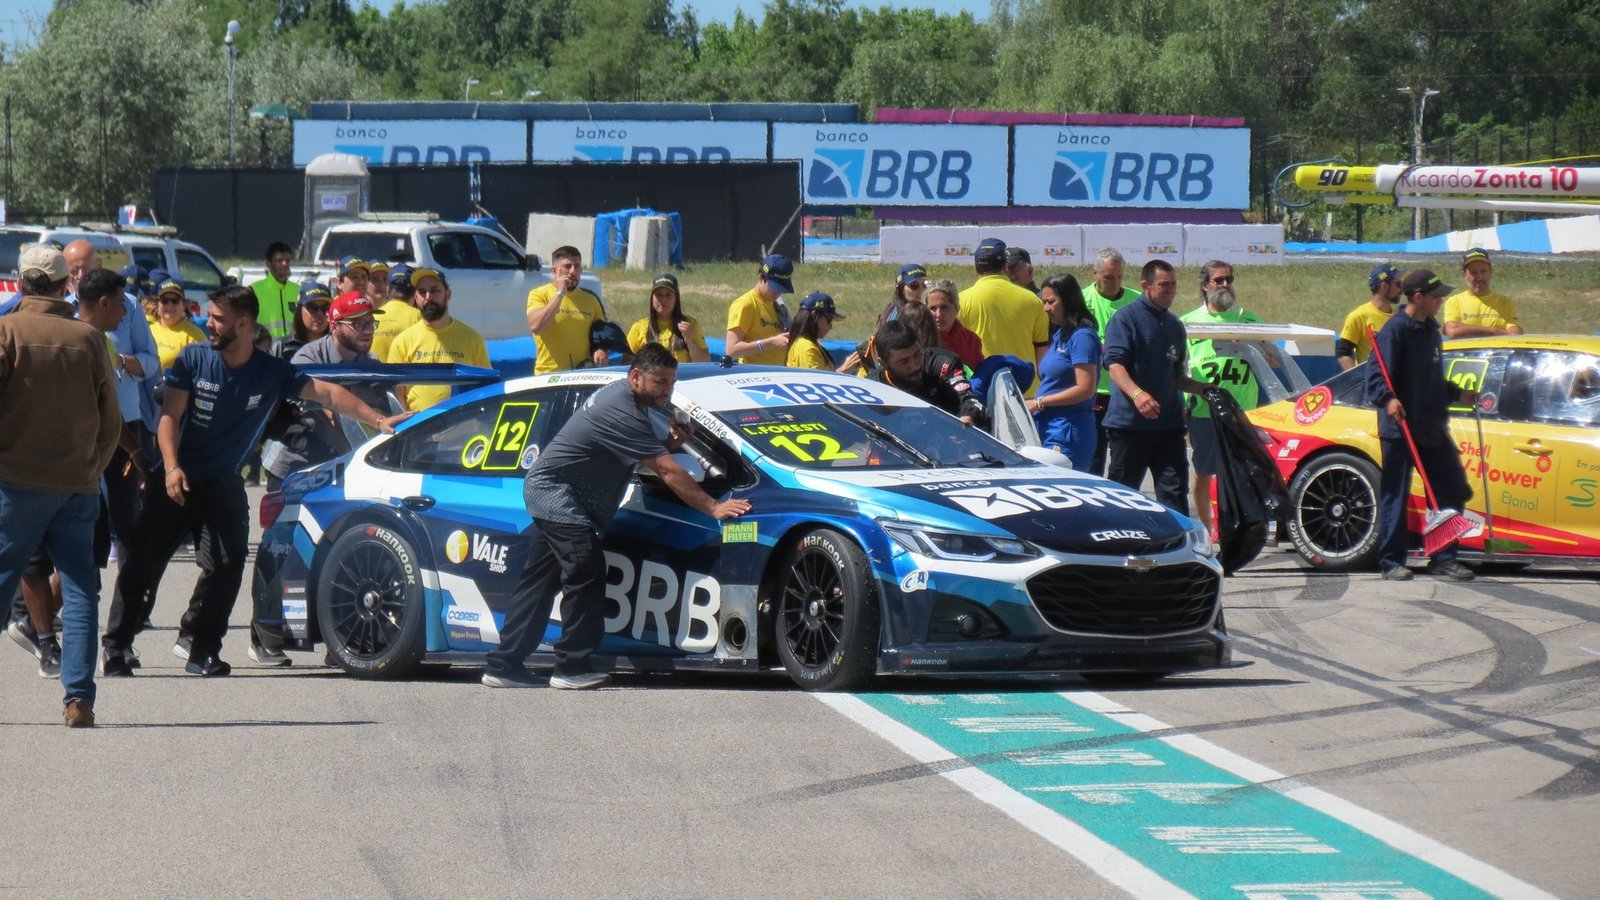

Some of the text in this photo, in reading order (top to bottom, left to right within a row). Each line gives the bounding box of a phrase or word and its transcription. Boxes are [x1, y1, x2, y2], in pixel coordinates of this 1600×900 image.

[335, 125, 388, 139] banco
[576, 125, 628, 140] banco
[816, 129, 869, 142] banco
[1057, 131, 1111, 145] banco
[866, 149, 972, 200] BRB
[1108, 151, 1214, 202] BRB
[1317, 168, 1349, 186] 90
[1550, 168, 1579, 191] 10
[727, 375, 772, 387] banco
[1202, 359, 1251, 386] 347
[784, 382, 885, 405] BRB
[690, 407, 728, 439] Eurobike
[743, 423, 827, 435] L.FORESTI
[495, 421, 527, 451] 12
[769, 434, 859, 462] 12
[1459, 441, 1491, 459] Shell
[920, 479, 993, 491] banco
[1009, 484, 1167, 513] BRB
[1501, 490, 1539, 512] Etanol
[728, 524, 753, 532] MANN
[728, 533, 753, 541] FILTER
[1091, 530, 1151, 542] CRUZE
[376, 528, 415, 585] Hankook
[472, 533, 509, 565] VALE
[489, 563, 507, 574] SHOP
[603, 550, 721, 654] BRB
[448, 610, 480, 622] COBREQ
